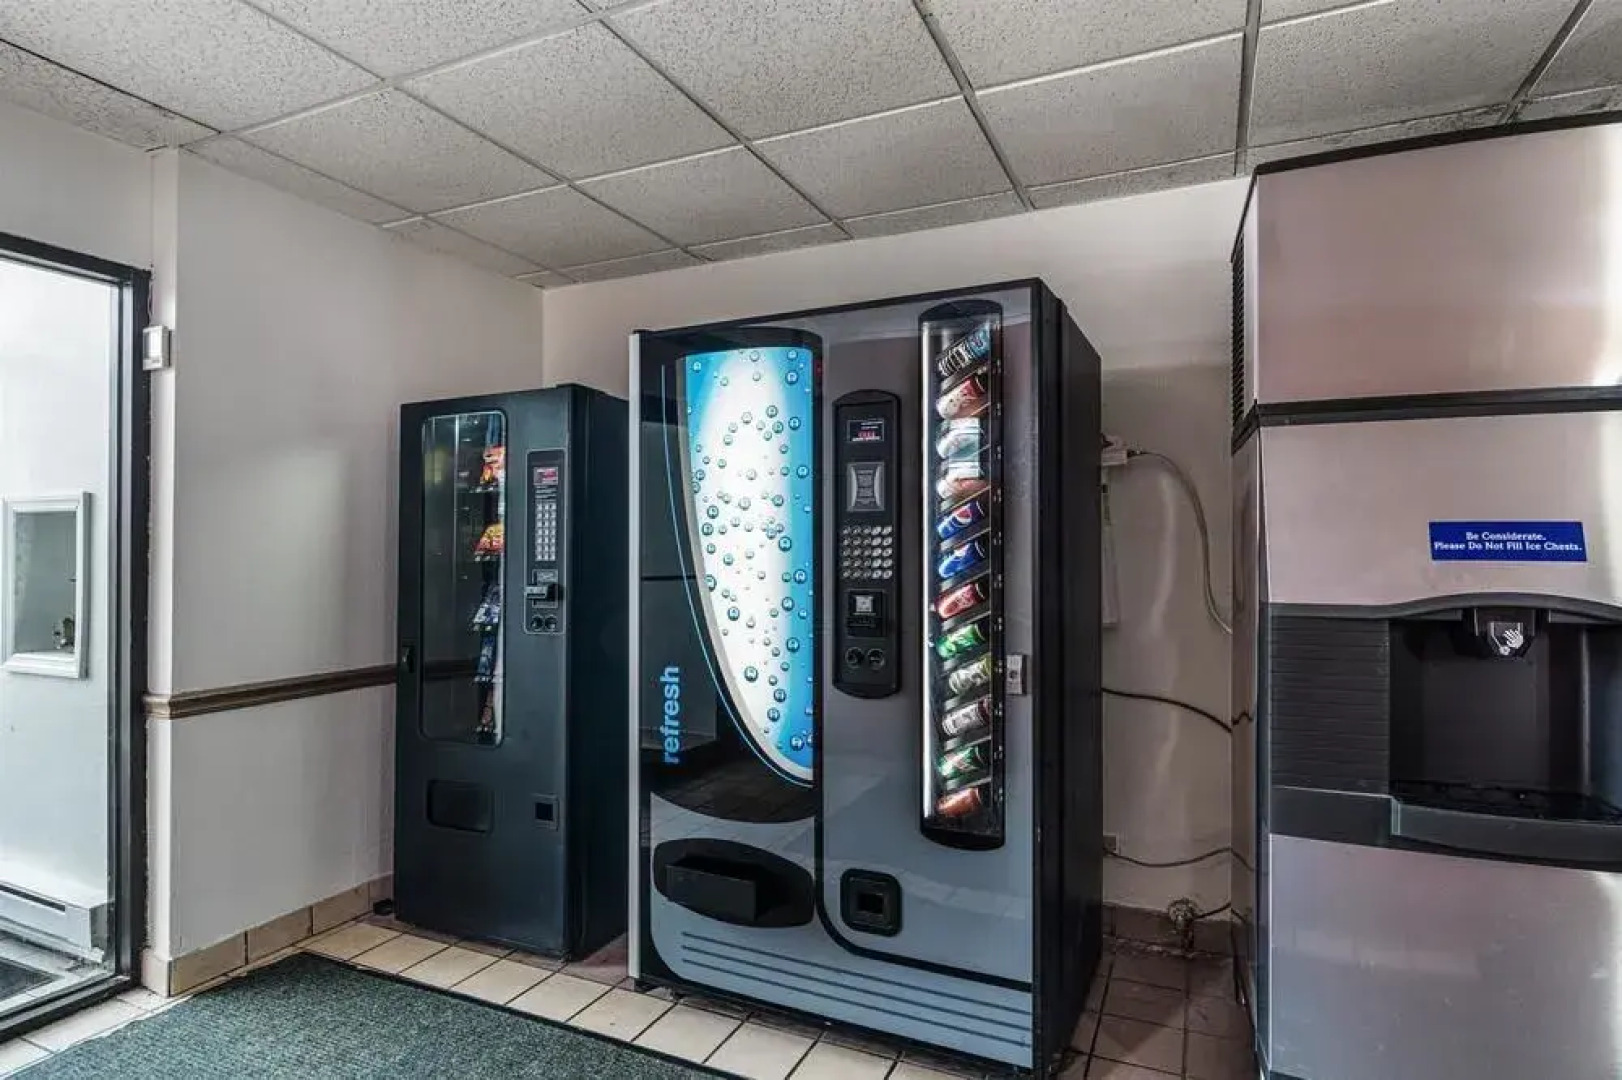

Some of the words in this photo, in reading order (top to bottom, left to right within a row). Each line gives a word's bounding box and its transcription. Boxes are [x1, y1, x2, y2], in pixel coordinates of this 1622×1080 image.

[1466, 531, 1479, 541] Be
[1481, 531, 1547, 541] Considerate.
[1434, 541, 1466, 551] Please
[1468, 541, 1483, 551] Do
[1485, 541, 1504, 551] Not
[1506, 541, 1522, 551] Fill
[1525, 541, 1541, 551] Ice
[1543, 541, 1583, 551] Chests.
[660, 667, 679, 764] refresh
